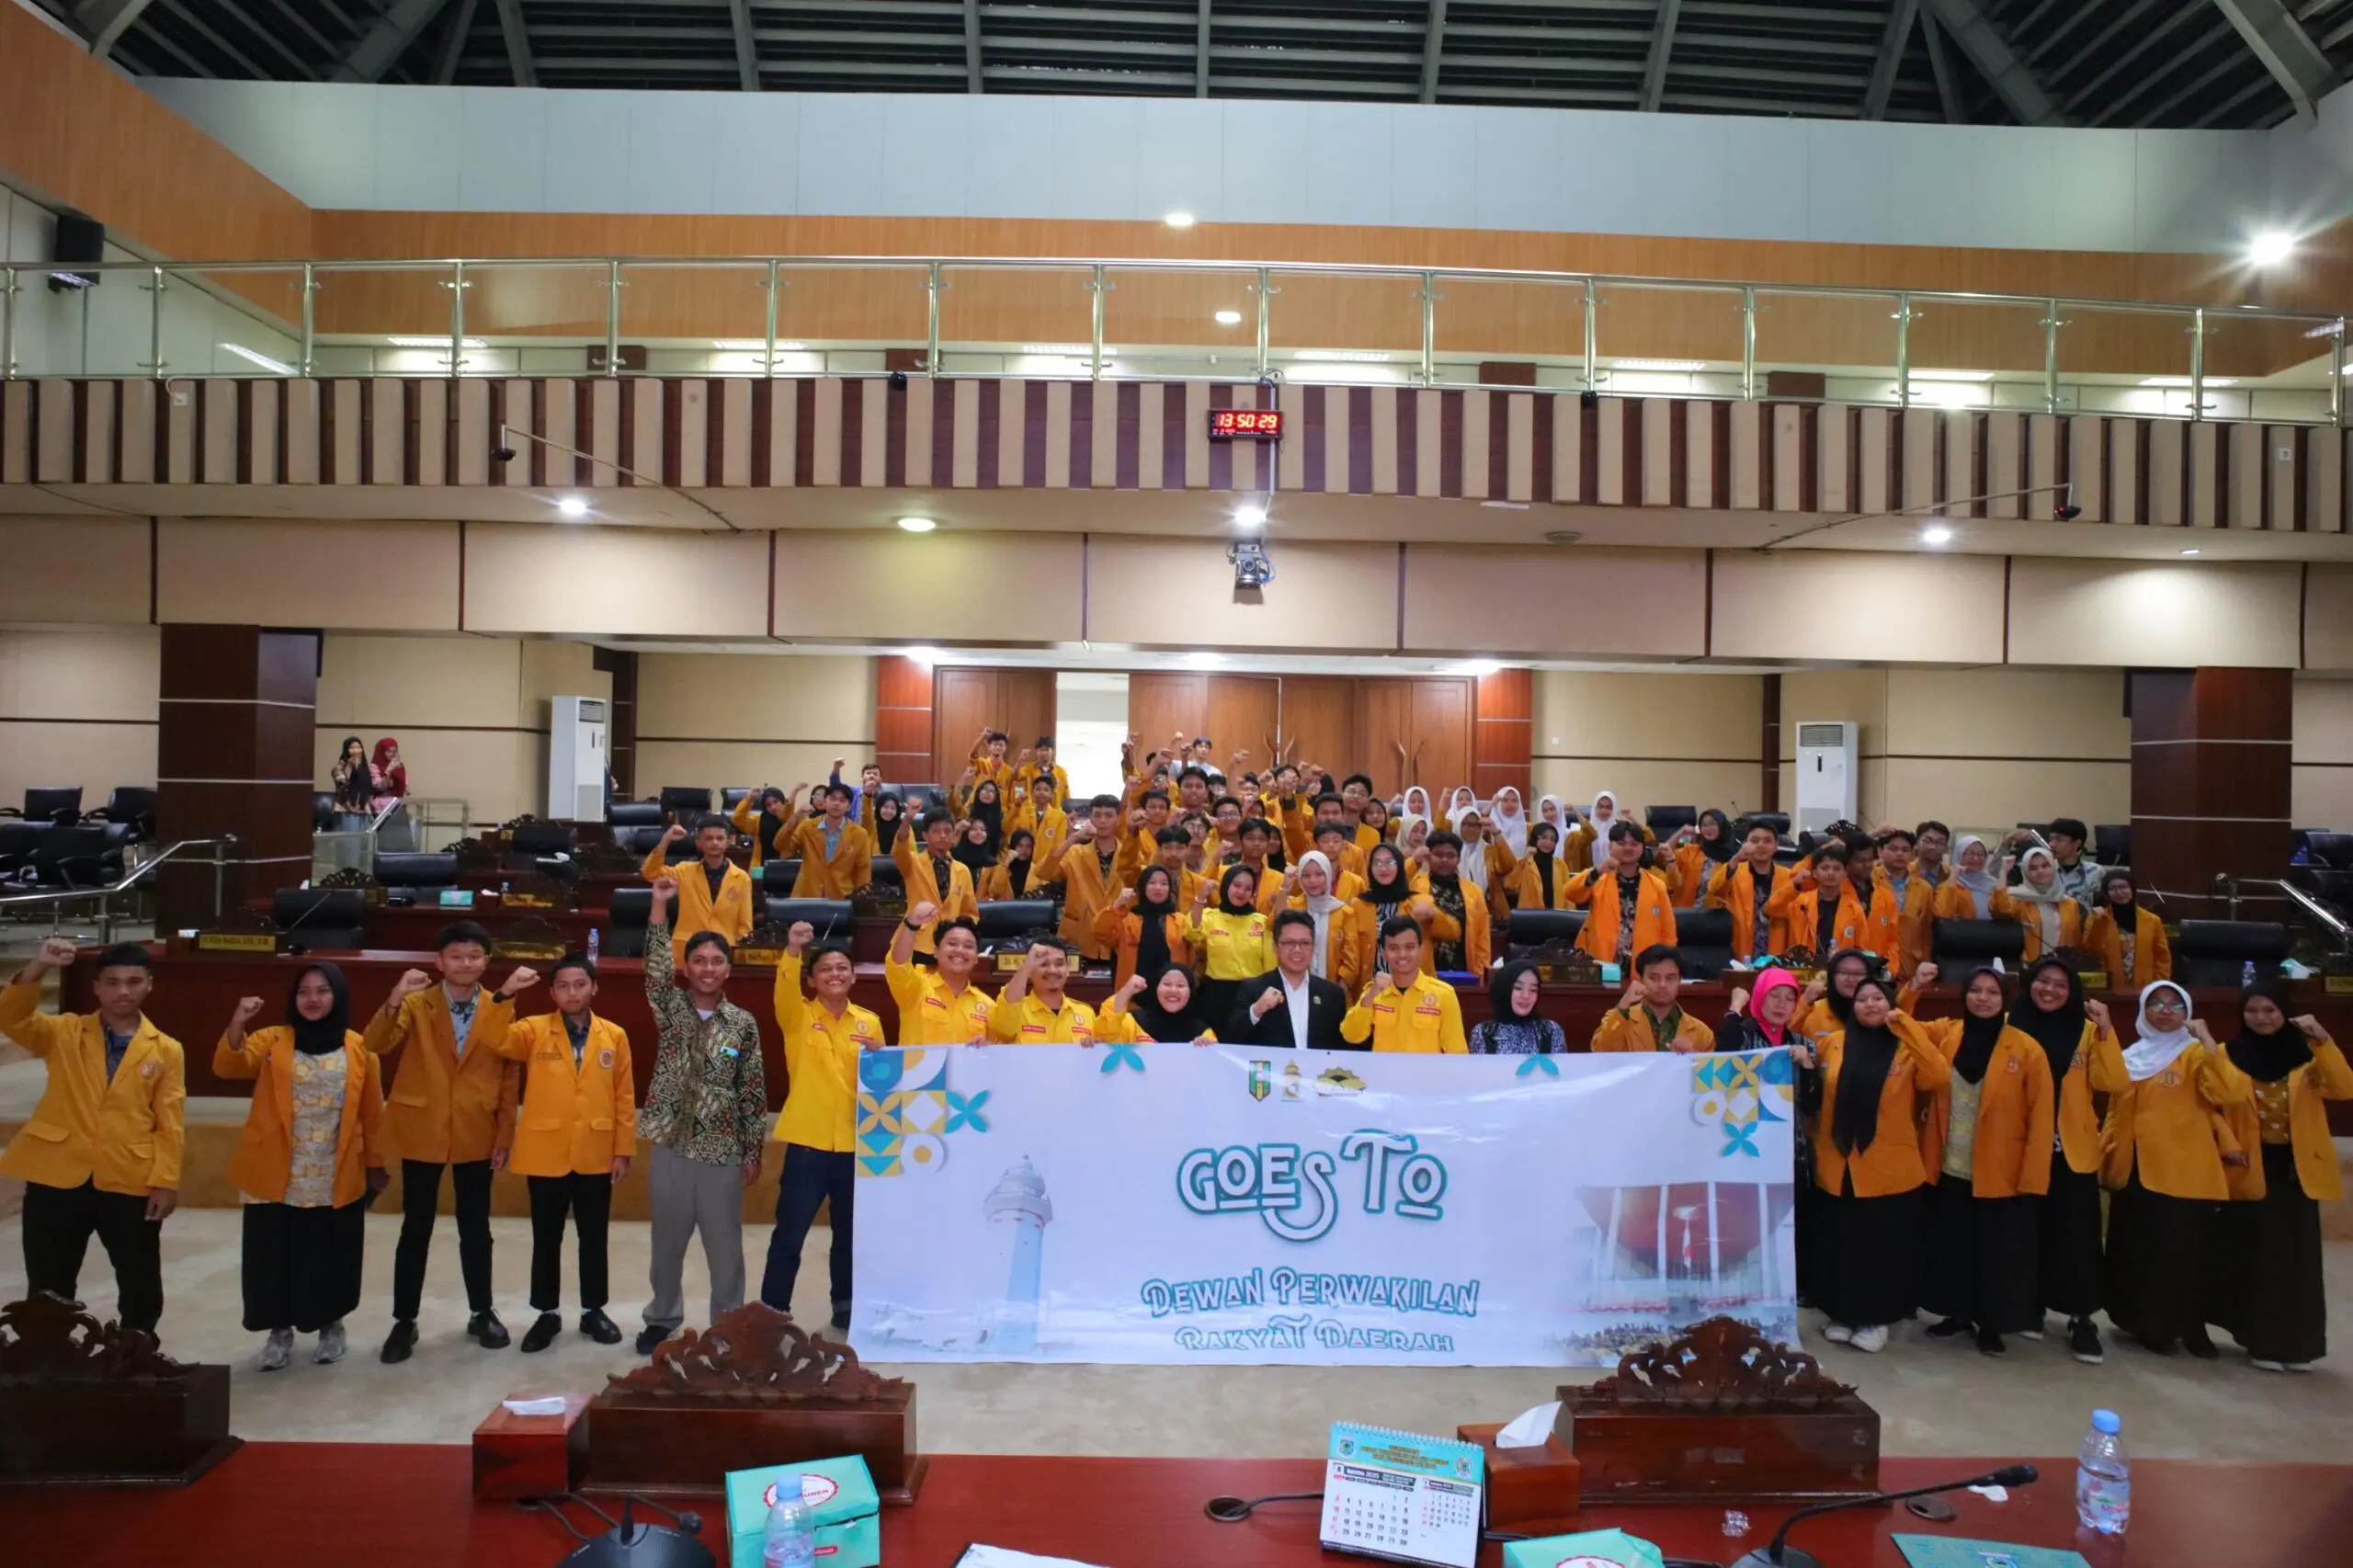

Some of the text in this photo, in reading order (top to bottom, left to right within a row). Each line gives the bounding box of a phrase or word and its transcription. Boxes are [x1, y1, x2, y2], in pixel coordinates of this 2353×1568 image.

[1176, 1129, 1448, 1242] GOES TO
[1141, 1265, 1481, 1318] DEWAN PERWAKILAN
[1175, 1313, 1455, 1352] RAKYAT DAERAH
